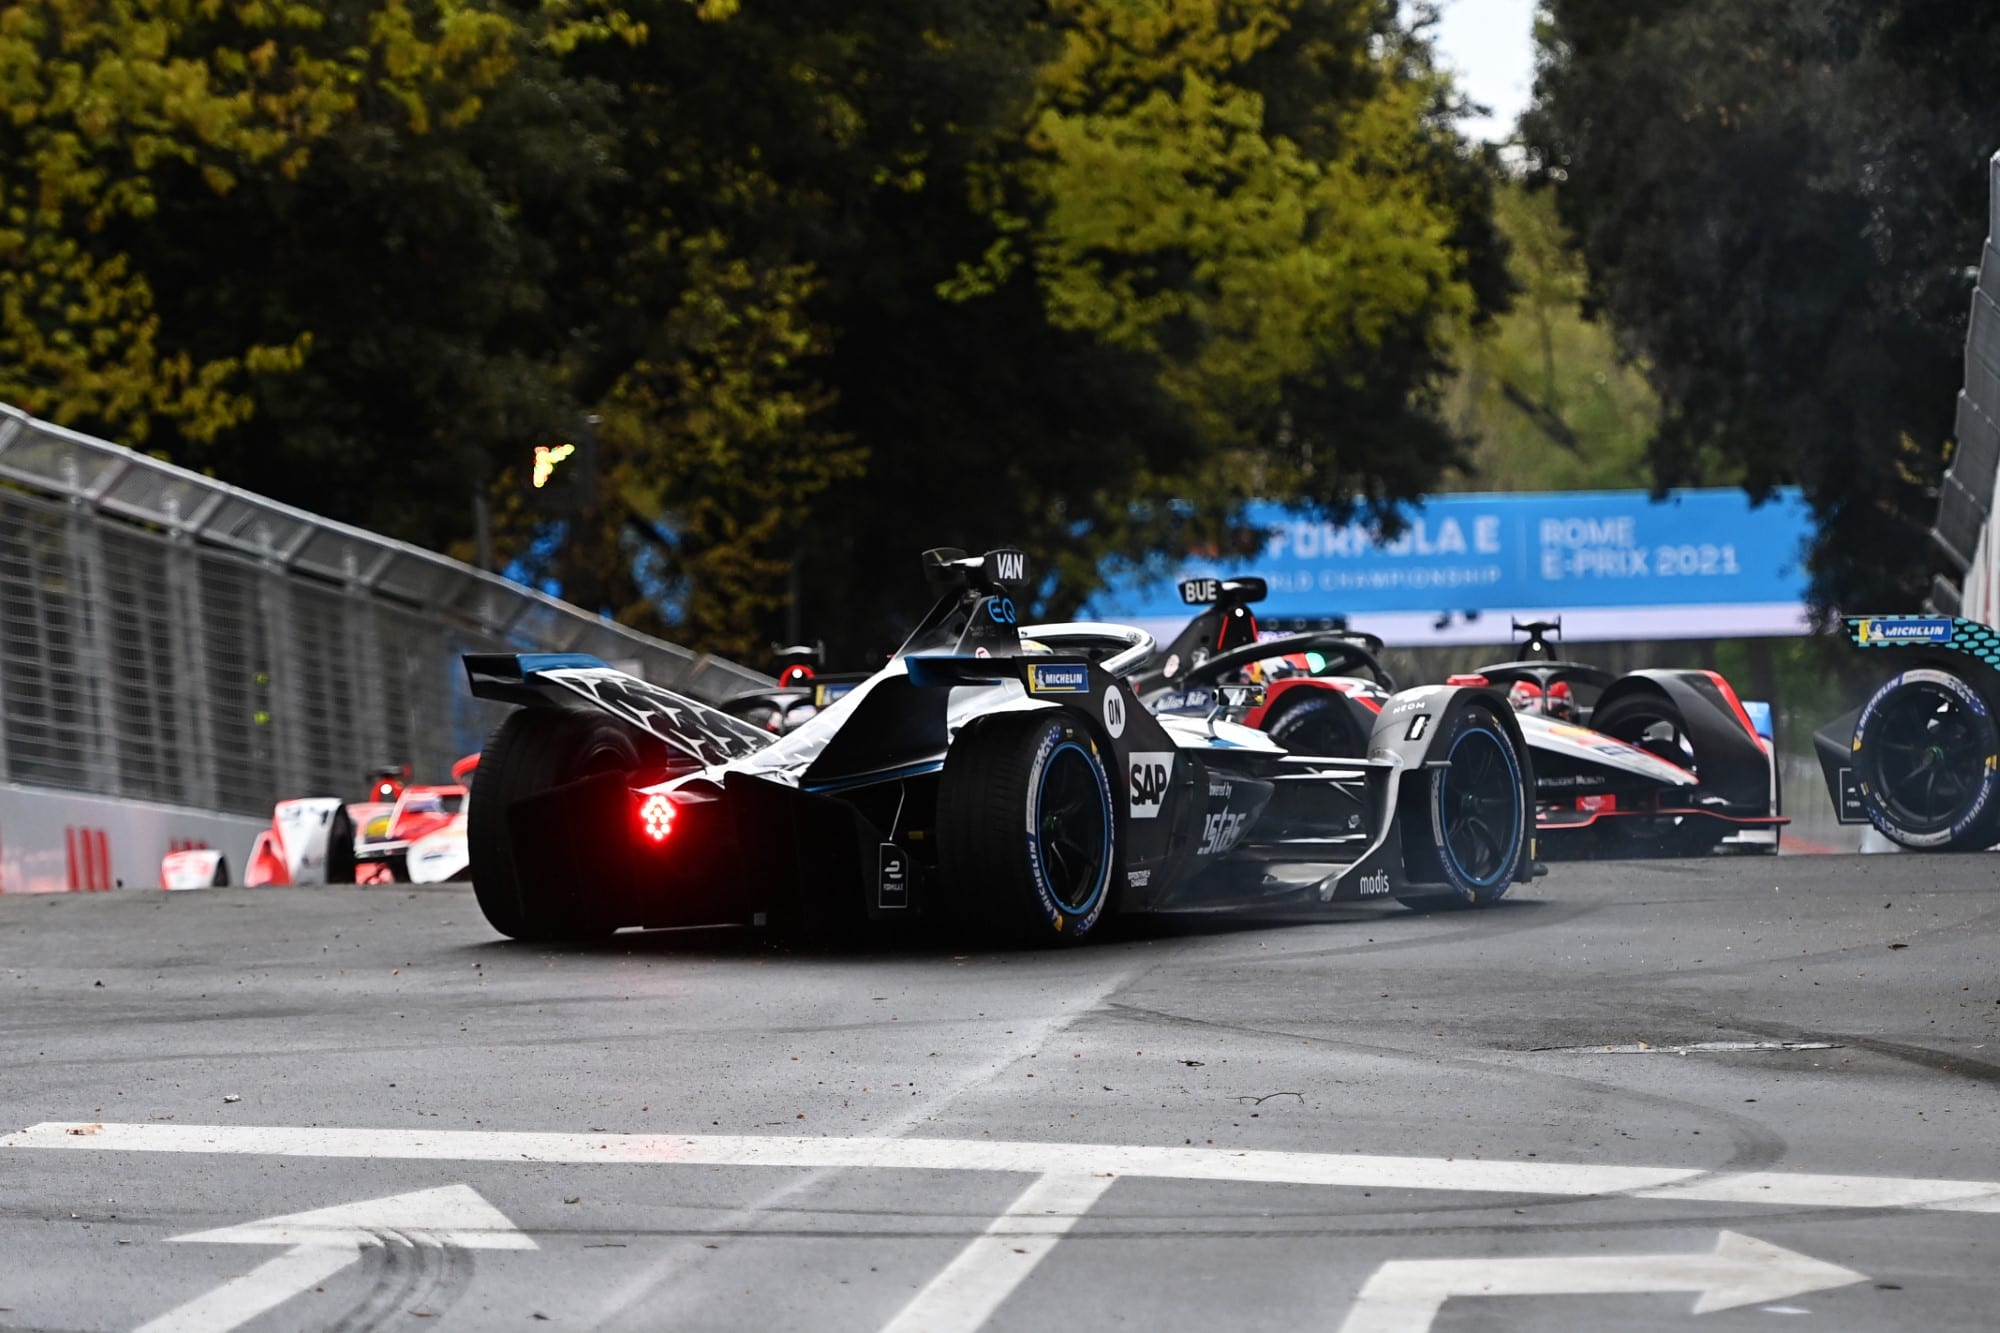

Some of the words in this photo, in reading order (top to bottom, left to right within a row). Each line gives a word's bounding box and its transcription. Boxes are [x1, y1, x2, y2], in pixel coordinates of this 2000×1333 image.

[1473, 513, 1500, 554] E
[1541, 517, 1635, 546] ROME
[997, 554, 1023, 579] VAN
[1543, 548, 1649, 579] E-PRIX
[1657, 544, 1740, 576] 2021
[1185, 581, 1217, 603] BUE
[988, 598, 1016, 624] EQ
[1885, 626, 1944, 636] MICHELIN
[1045, 673, 1082, 684] MICHELIN
[1108, 699, 1121, 725] ON
[1393, 702, 1425, 714] NEOM
[1131, 764, 1167, 805] SAP
[1029, 840, 1052, 912] MICHELIN
[1360, 868, 1390, 895] modis
